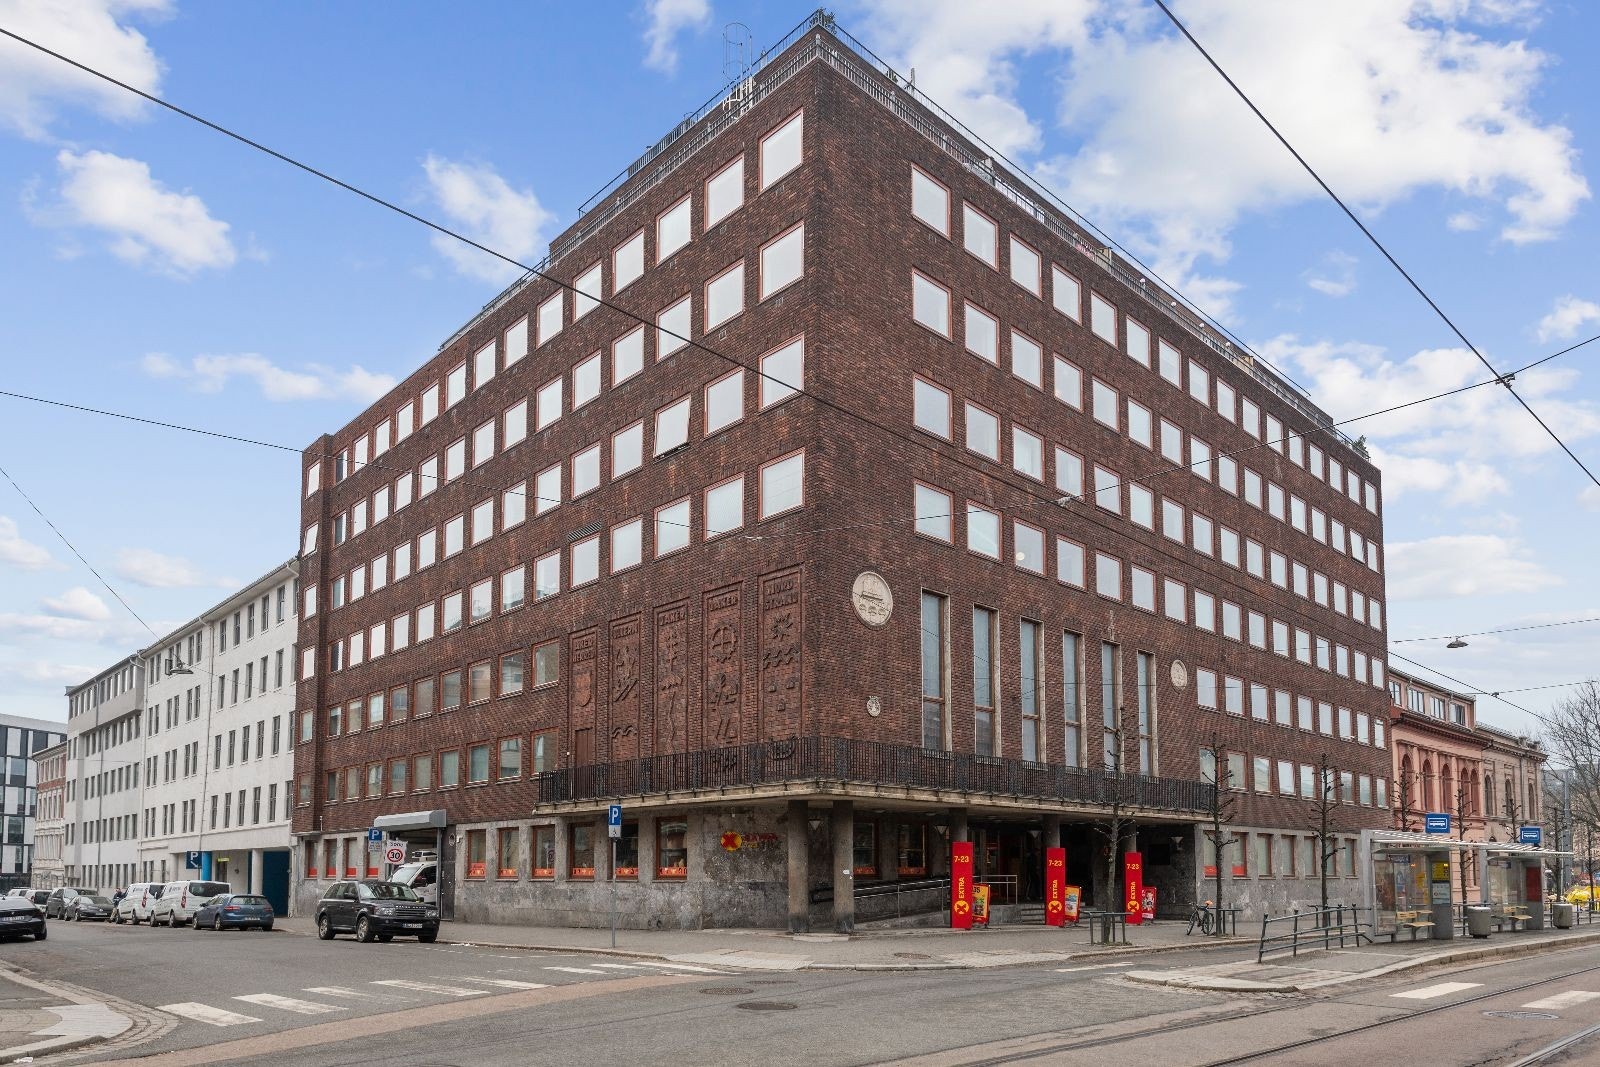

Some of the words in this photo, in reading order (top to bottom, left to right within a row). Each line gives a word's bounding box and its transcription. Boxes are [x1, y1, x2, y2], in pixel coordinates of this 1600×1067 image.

[612, 807, 619, 824] P
[371, 829, 380, 840] P
[190, 851, 199, 861] P
[389, 851, 401, 860] 30
[953, 855, 970, 863] 7-23
[1048, 859, 1063, 867] 7-23
